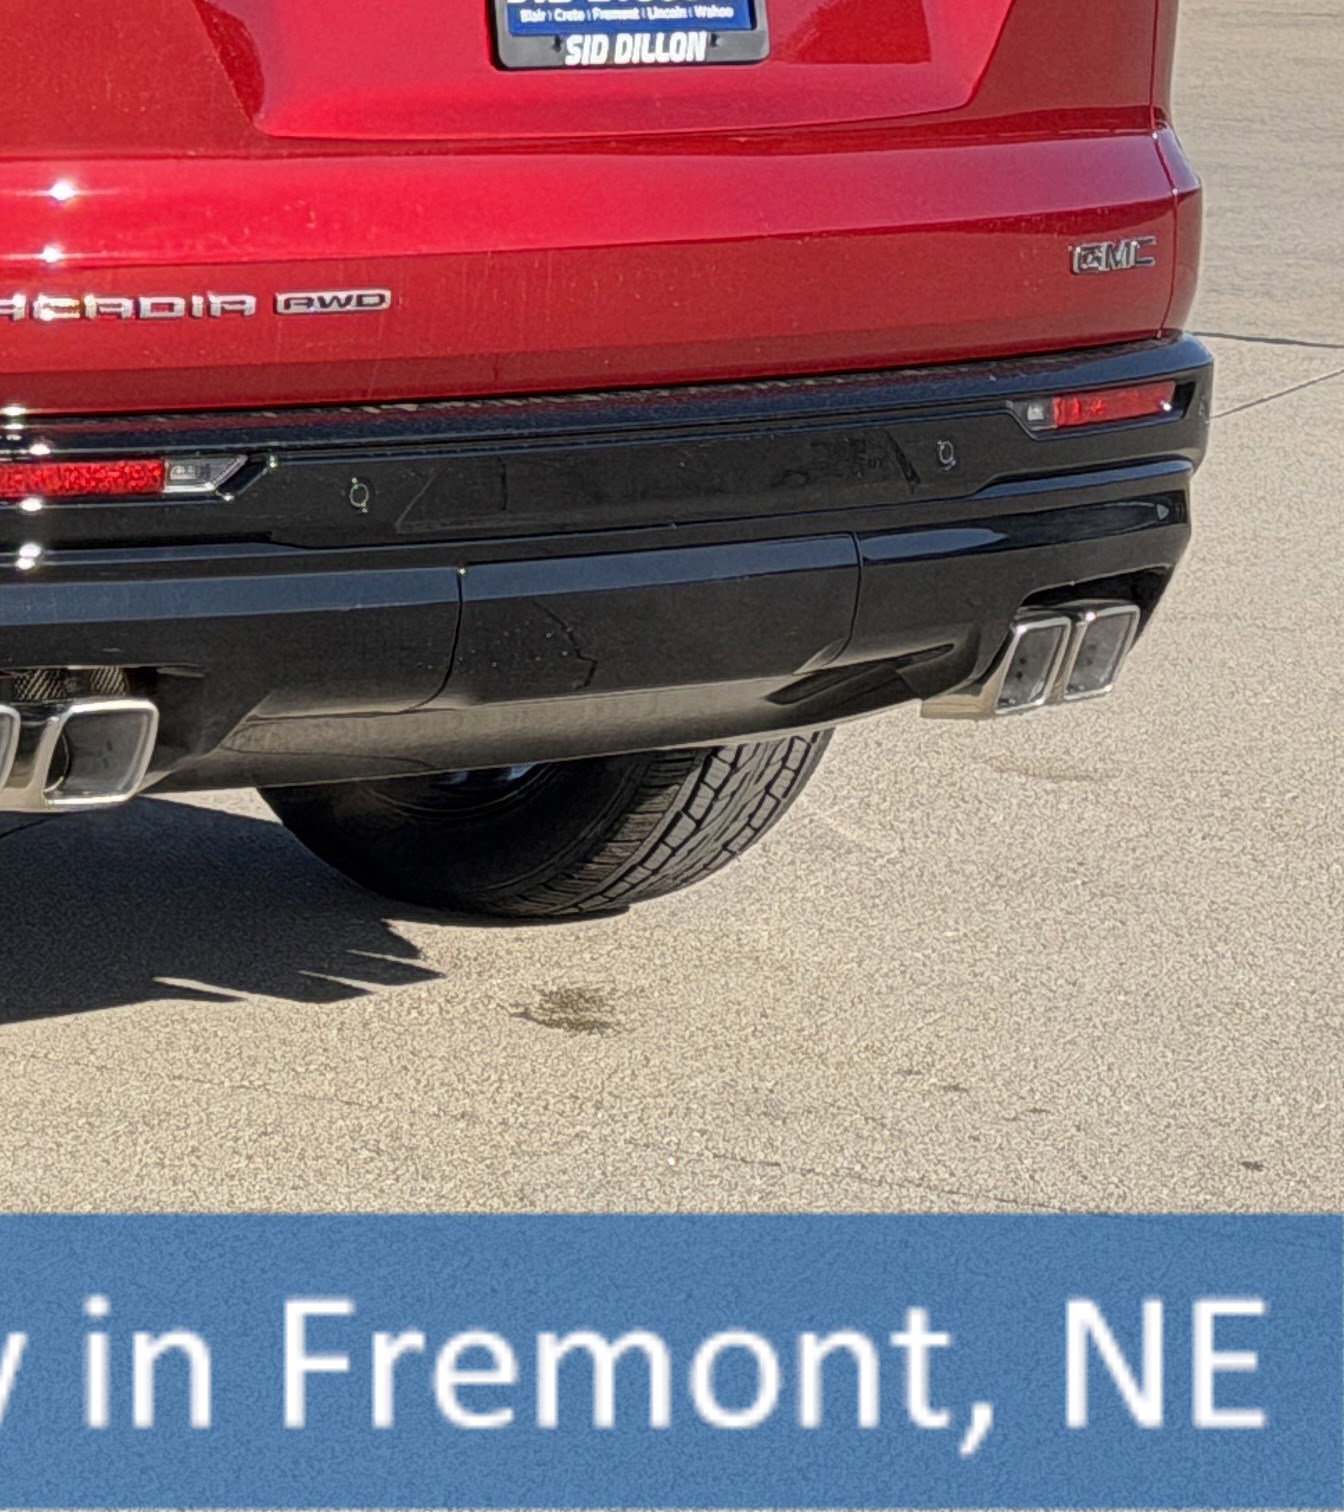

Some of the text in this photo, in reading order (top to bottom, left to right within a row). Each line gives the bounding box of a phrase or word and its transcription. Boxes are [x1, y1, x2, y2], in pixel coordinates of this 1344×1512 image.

[565, 30, 707, 65] SID DILLON
[1071, 235, 1158, 274] GMC
[279, 290, 389, 313] AWD
